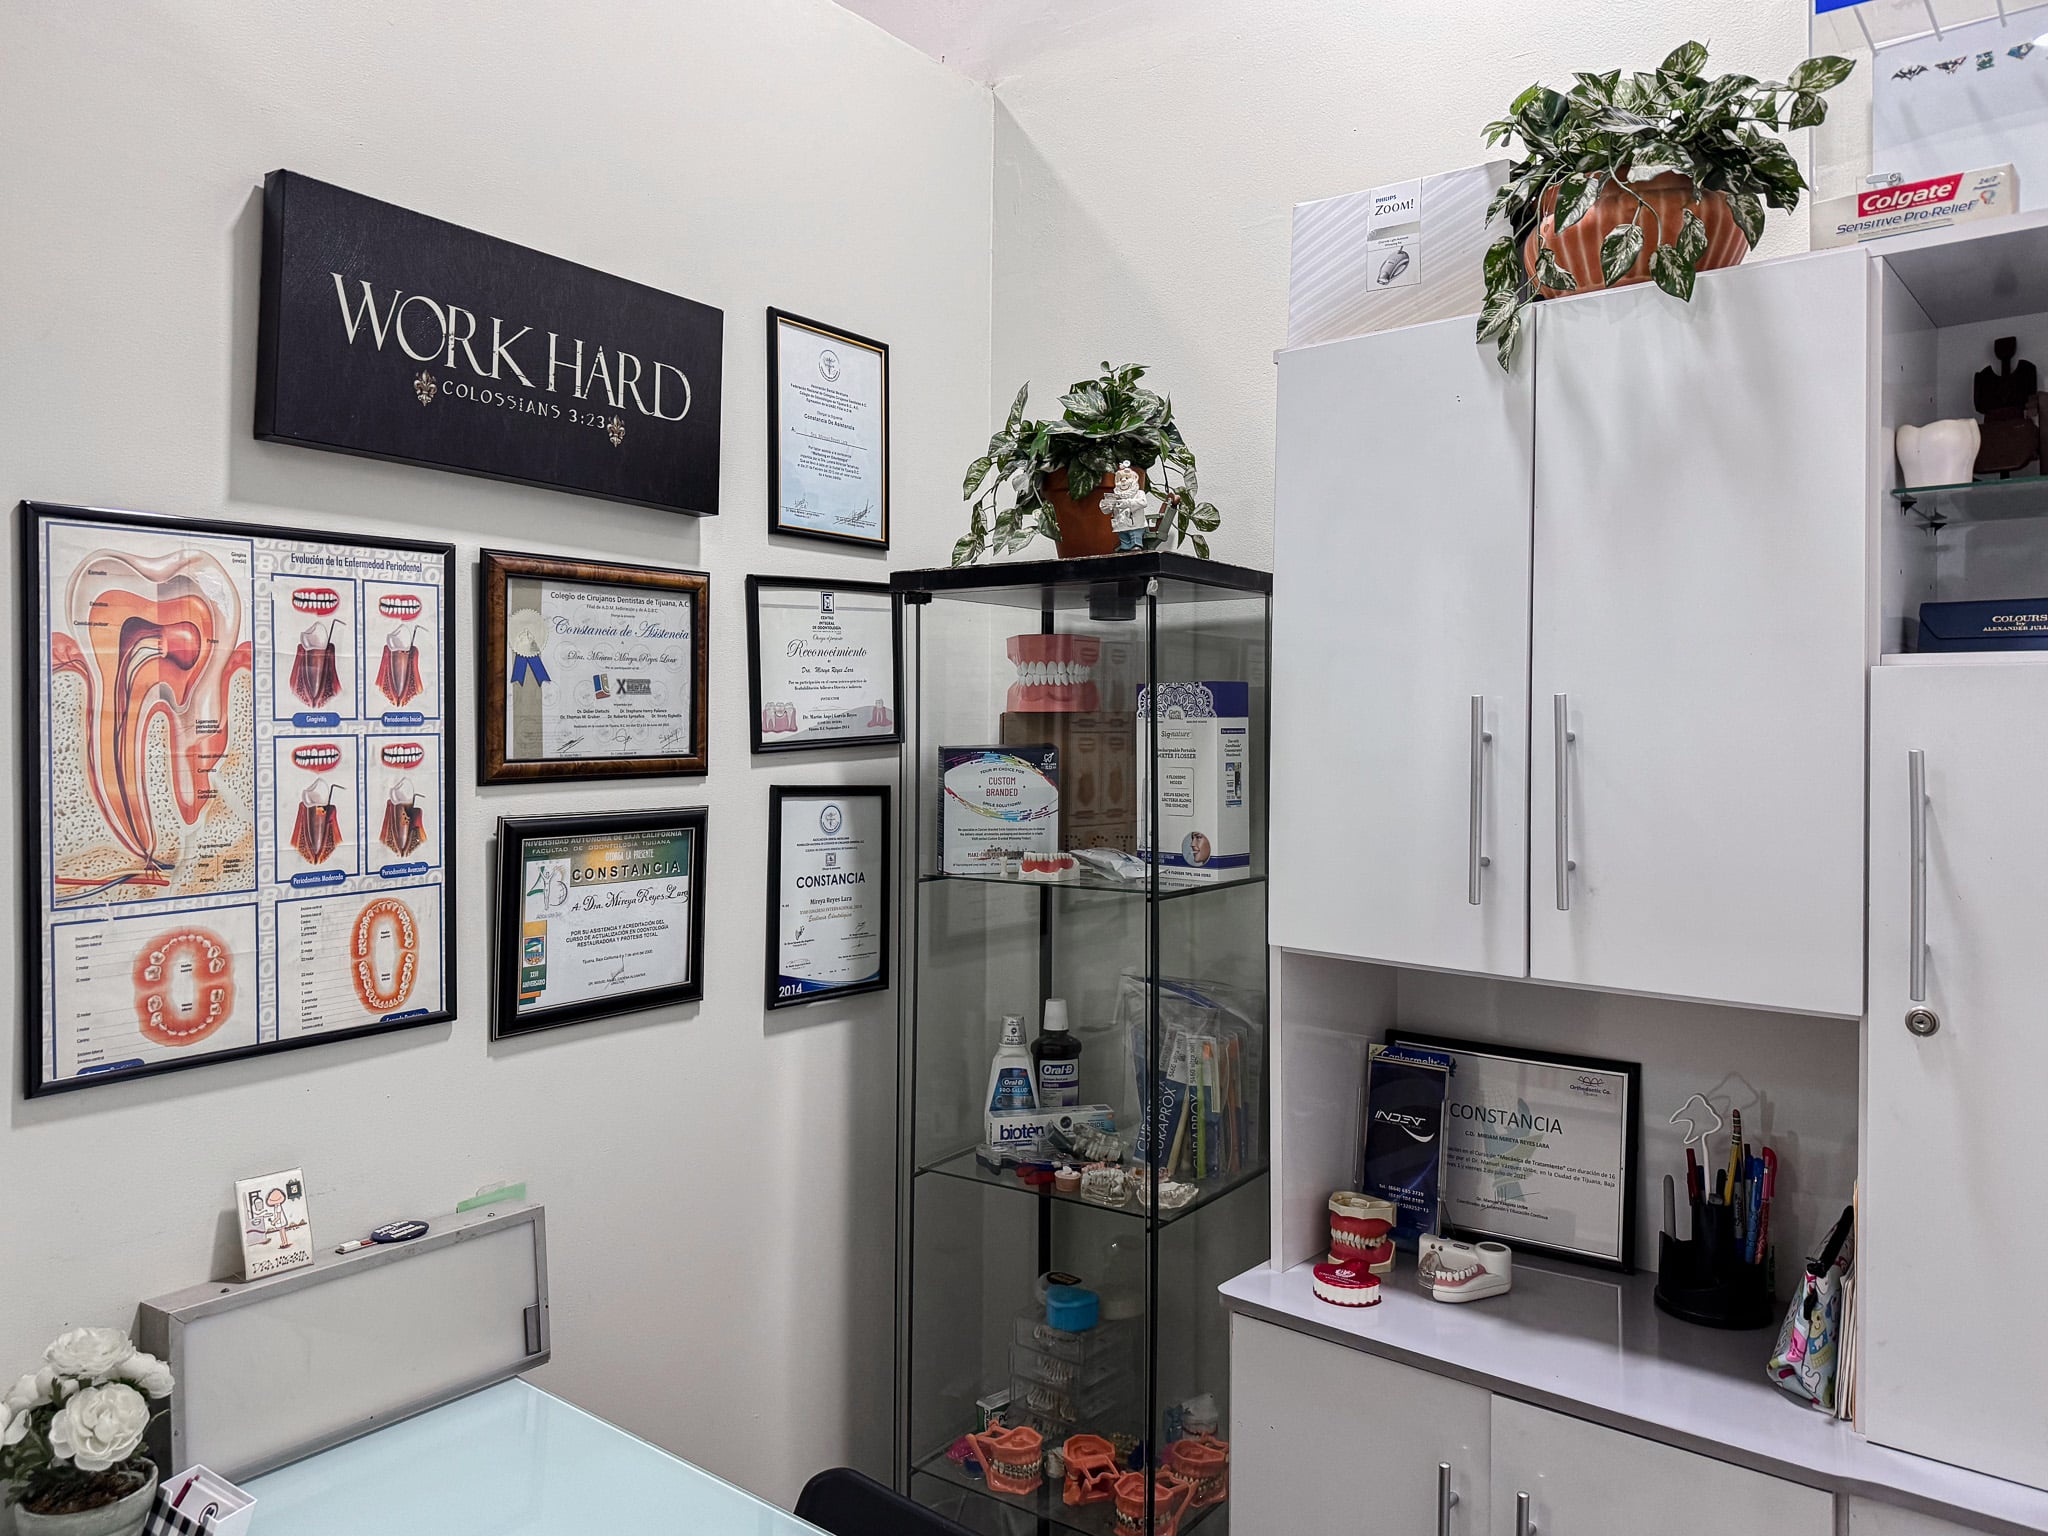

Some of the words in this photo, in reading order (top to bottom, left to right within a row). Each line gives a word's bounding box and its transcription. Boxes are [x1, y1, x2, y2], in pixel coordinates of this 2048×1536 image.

[1376, 195, 1396, 203] PHILIPS
[1862, 184, 1953, 211] Colgate
[1375, 199, 1413, 216] ZOOM!
[1836, 216, 1900, 234] Sensitive
[330, 272, 536, 390] WORK
[546, 331, 692, 422] HARD
[441, 380, 562, 420] COLOSSIANS
[568, 409, 606, 430] 3:23
[804, 413, 827, 424] Constancia
[291, 553, 324, 565] Evolución
[325, 556, 335, 566] de
[336, 557, 343, 566] la
[344, 558, 385, 570] Enfermedad
[386, 561, 422, 572] Periodontal
[551, 591, 575, 601] Colegio
[587, 594, 616, 603] Cirujanos
[617, 596, 644, 605] Dentistas
[655, 600, 677, 608] Tijuana,
[1992, 614, 2048, 623] COLOURS
[552, 615, 617, 637] Constancia
[620, 625, 632, 637] de
[634, 620, 689, 640] Asistencia
[787, 639, 867, 657] Reconocimiento
[306, 715, 327, 723] Gingivitis
[1161, 731, 1191, 739] Signature
[988, 777, 1016, 785] CUSTOM
[986, 788, 1018, 797] BRANDED
[525, 839, 569, 847] NIVERSIDAD
[382, 868, 407, 876] Periodontitis
[572, 860, 681, 882] CONSTANCIA
[293, 877, 321, 885] Periodontitis
[322, 874, 344, 883] Moderada
[796, 872, 865, 888] CONSTANCIA
[605, 890, 636, 908] Mireya
[637, 886, 664, 906] Reyes
[590, 926, 617, 934] ASISTENCIA
[577, 938, 615, 947] RESTAURADORA
[778, 982, 802, 998] 2014
[1043, 1065, 1072, 1074] Oral-B
[1450, 1103, 1563, 1134] CONSTANCIA
[1499, 1136, 1519, 1144] MIREYA
[1520, 1138, 1535, 1147] REYES
[1536, 1140, 1550, 1149] LARA
[1553, 1172, 1572, 1180] Ciudad
[1604, 1180, 1615, 1188] Baja
